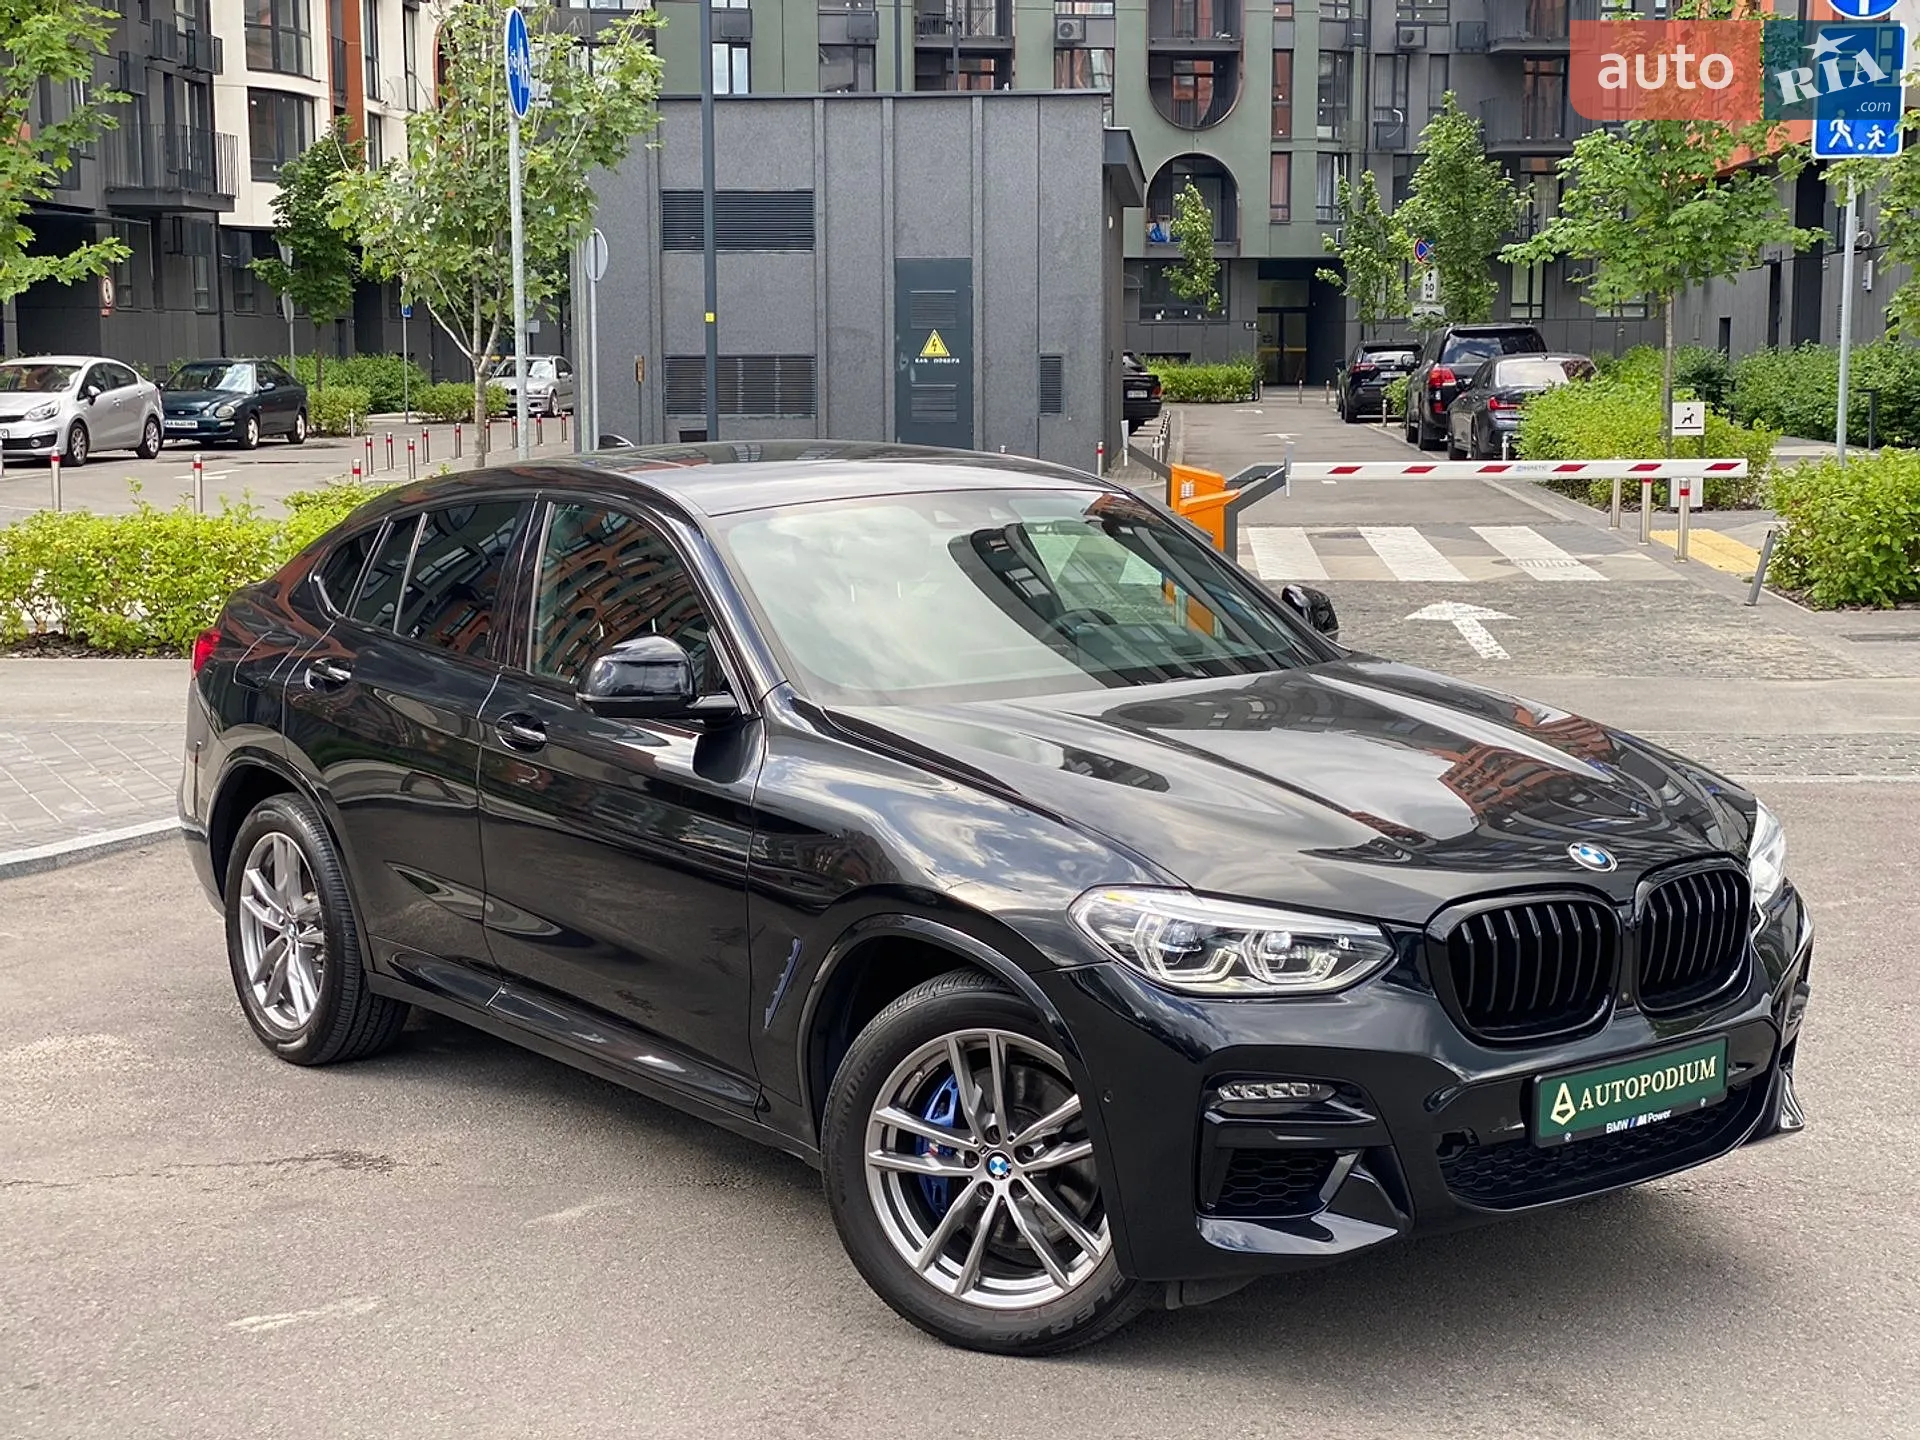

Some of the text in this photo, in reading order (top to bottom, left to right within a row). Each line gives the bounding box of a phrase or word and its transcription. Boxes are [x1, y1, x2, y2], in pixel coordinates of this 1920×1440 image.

[1425, 283, 1435, 292] 10
[1579, 1055, 1717, 1112] AUTOPODIUM
[1606, 1118, 1630, 1134] BMW
[1647, 1109, 1672, 1123] Power
